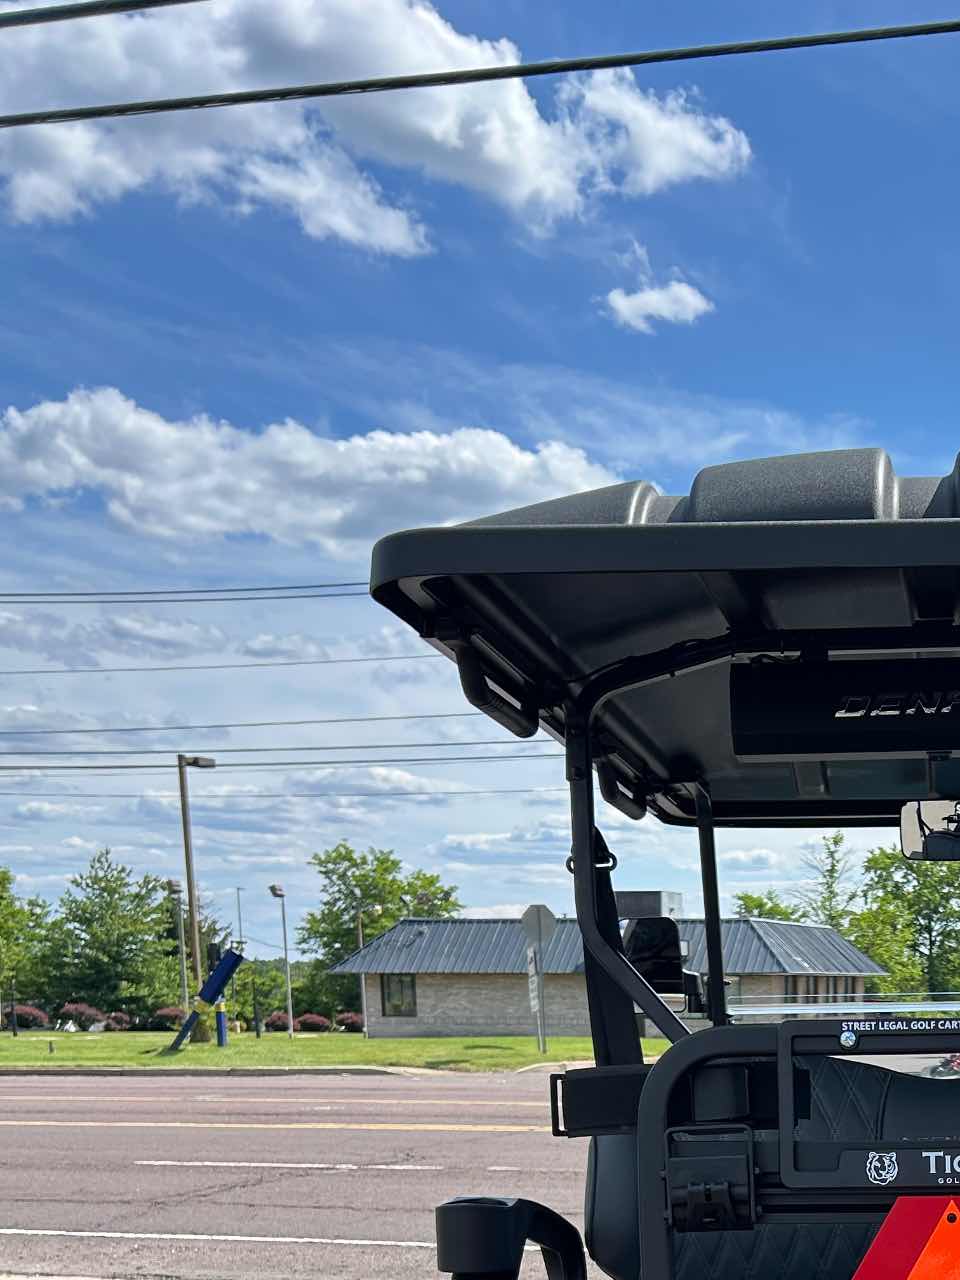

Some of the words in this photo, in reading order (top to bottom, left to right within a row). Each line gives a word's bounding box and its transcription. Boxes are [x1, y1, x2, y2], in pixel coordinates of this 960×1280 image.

[841, 1021, 876, 1031] STREET
[878, 1021, 909, 1031] LEGAL
[910, 1020, 936, 1030] GOLF
